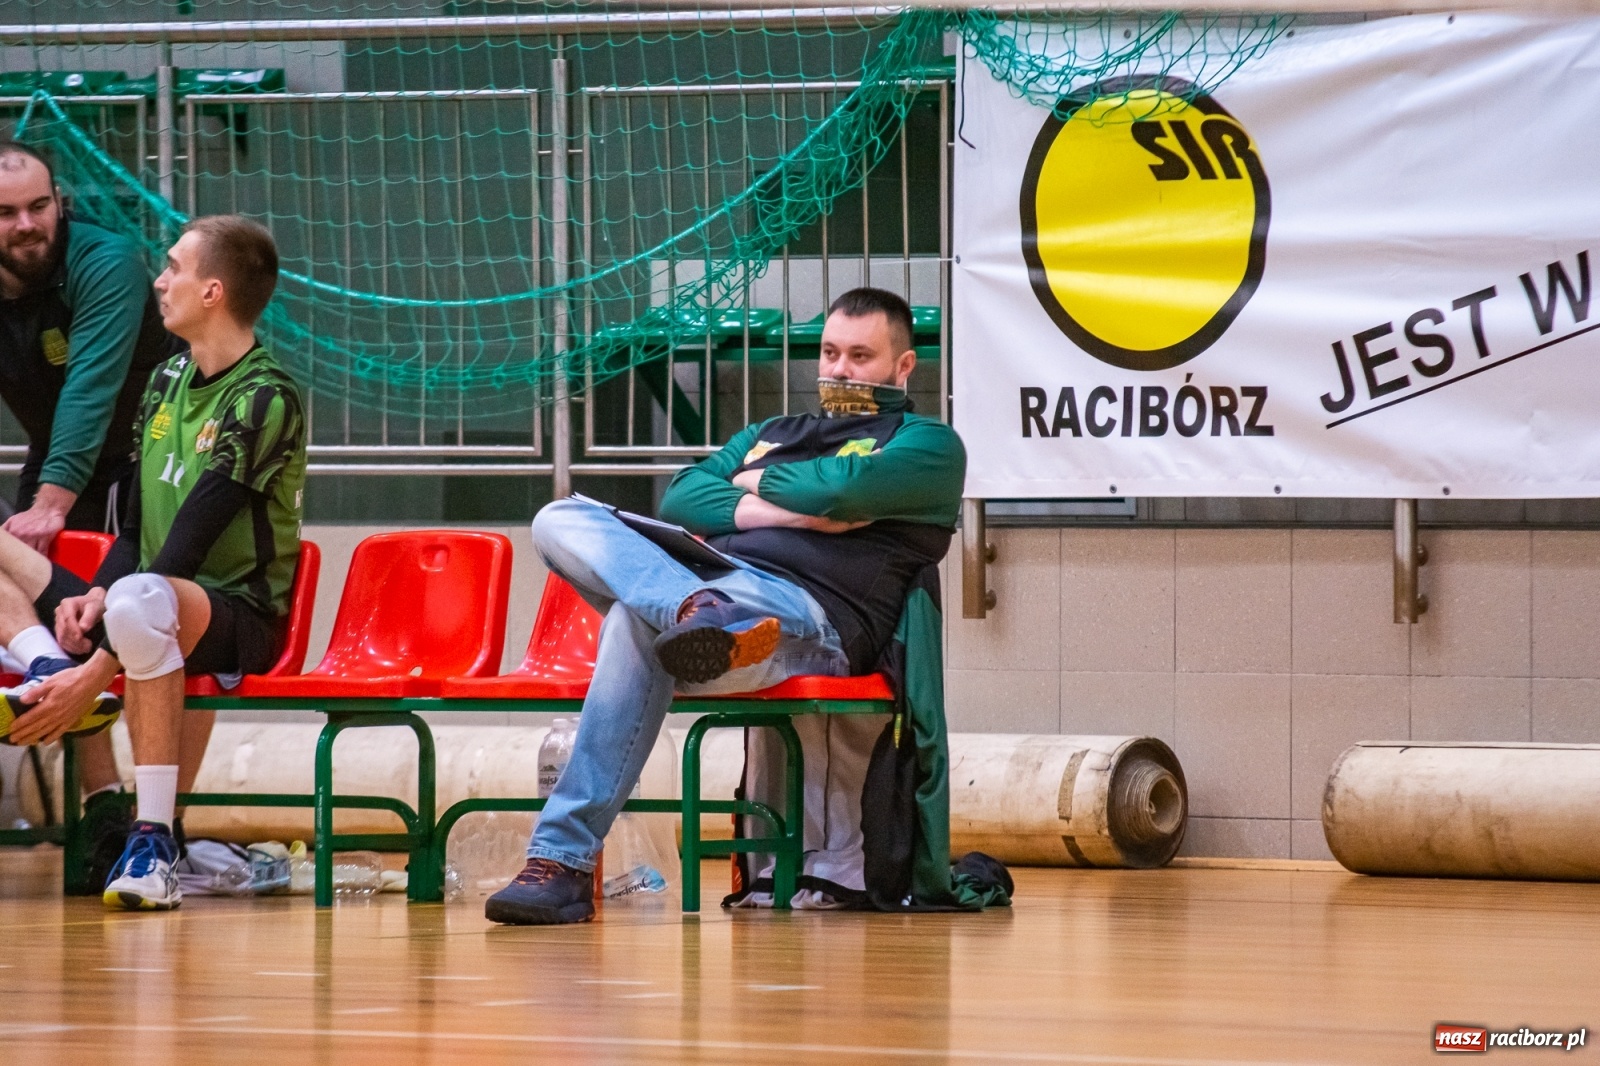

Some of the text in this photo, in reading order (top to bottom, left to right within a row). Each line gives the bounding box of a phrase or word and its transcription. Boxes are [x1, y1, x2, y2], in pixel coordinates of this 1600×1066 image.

[1131, 119, 1262, 181] SIR
[1320, 250, 1592, 414] JEST W
[1020, 372, 1275, 438] RACIBÓRZ
